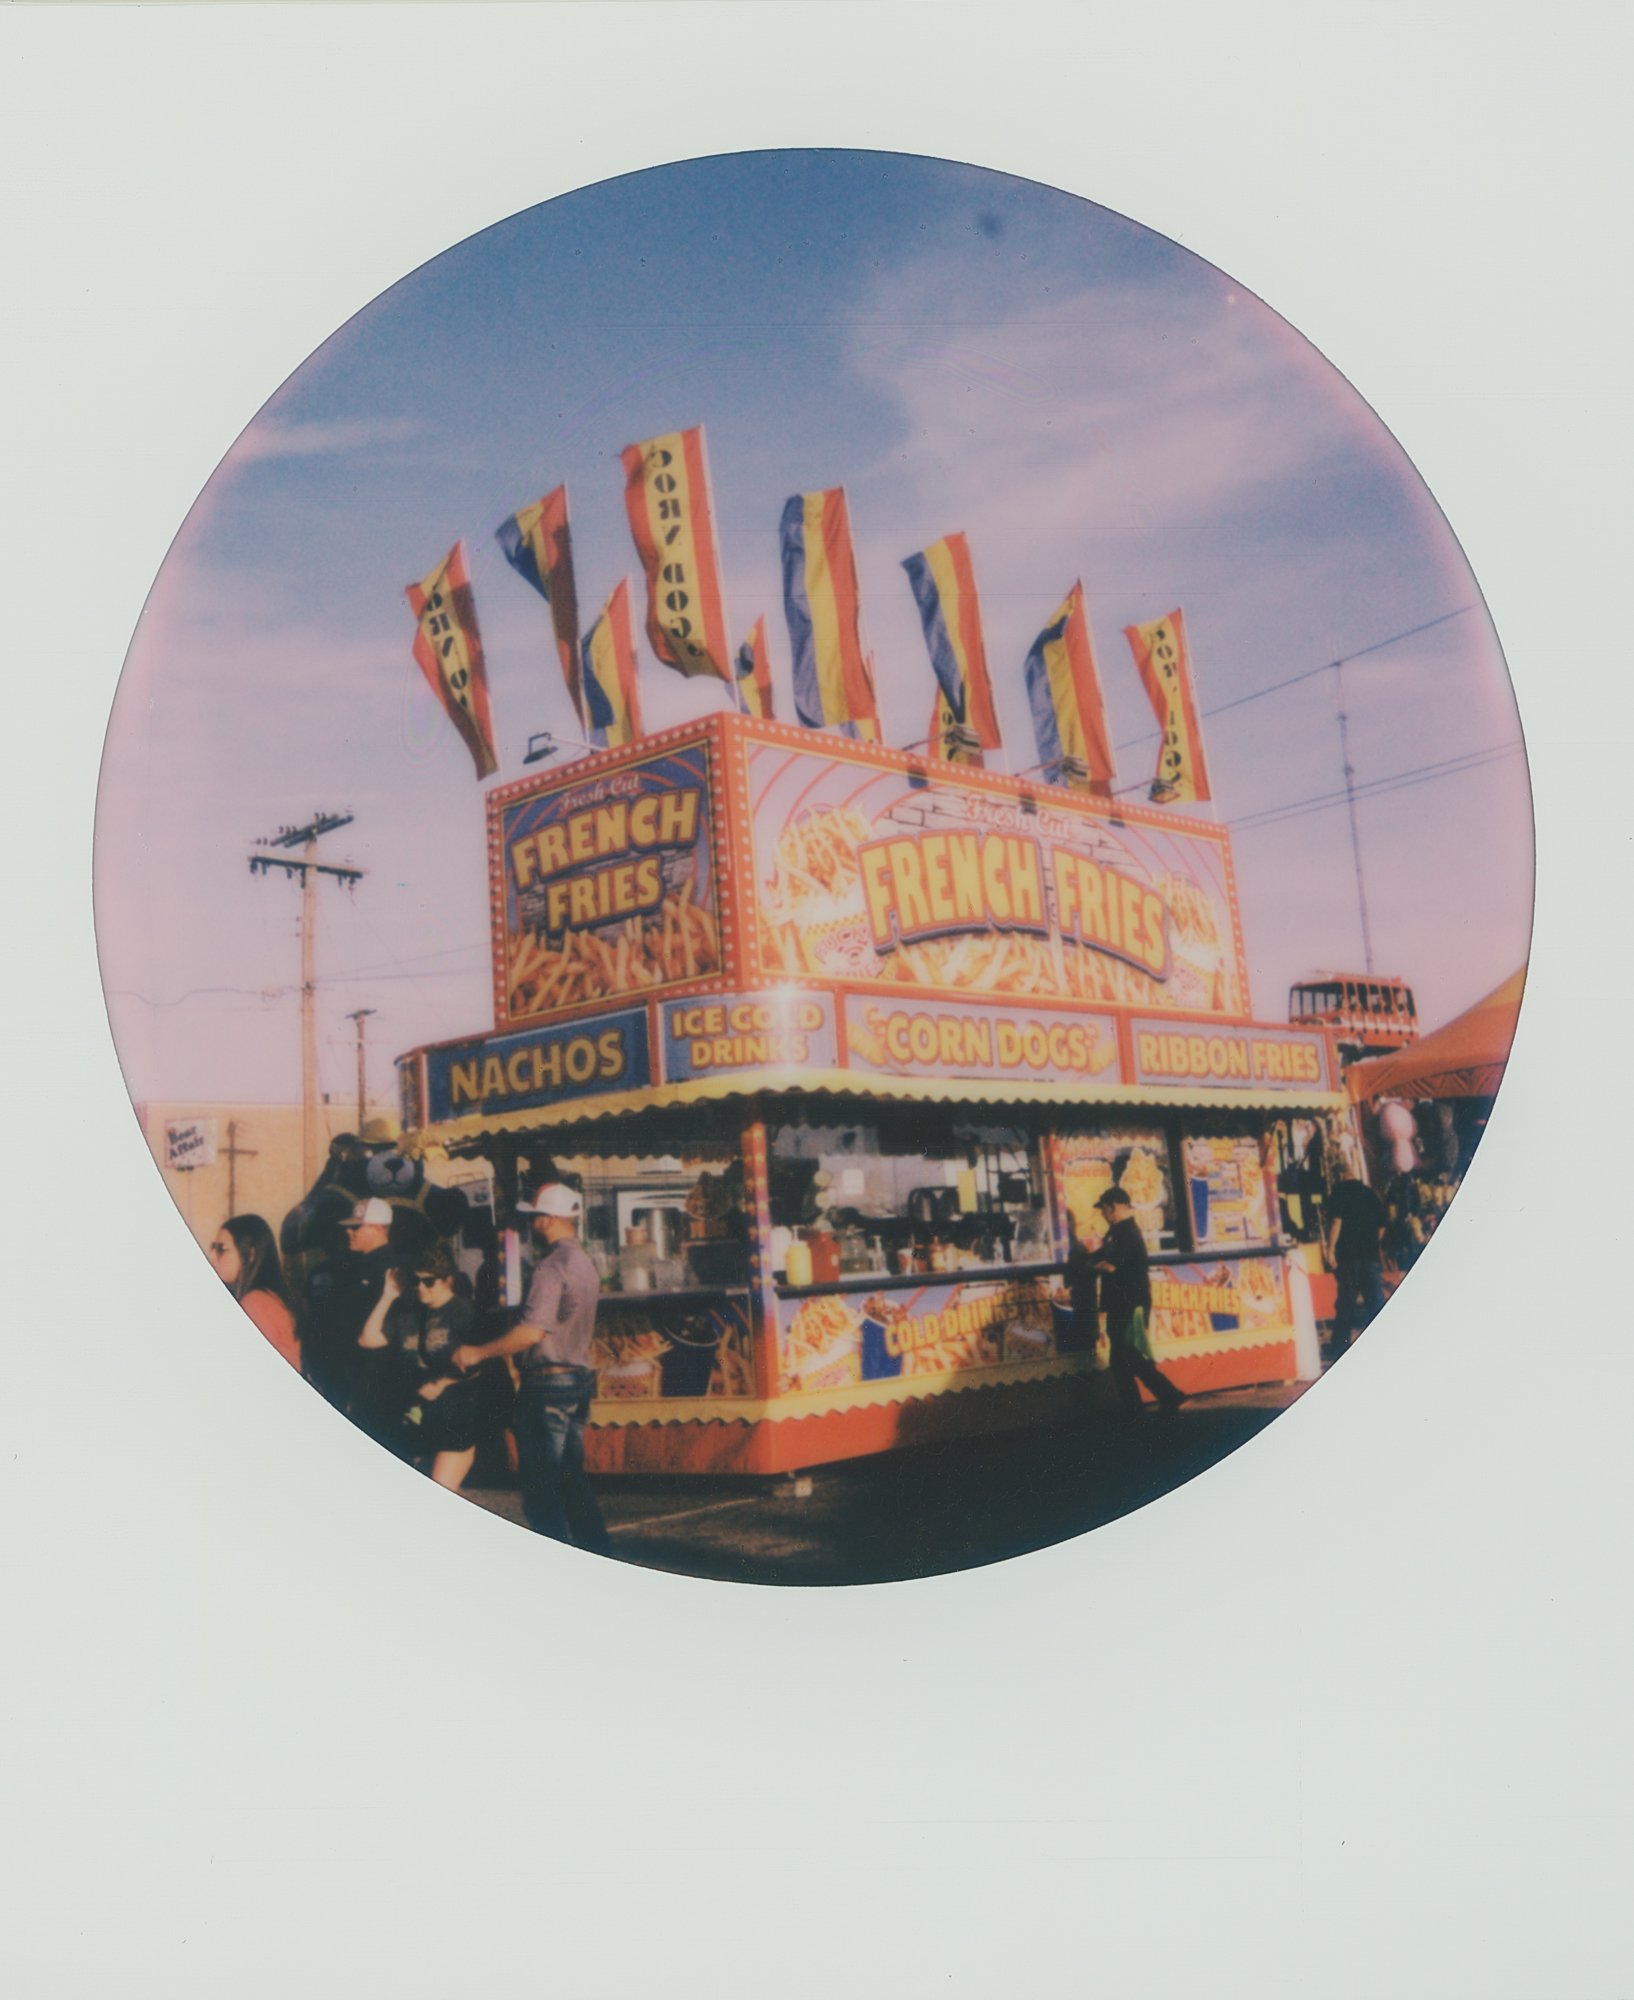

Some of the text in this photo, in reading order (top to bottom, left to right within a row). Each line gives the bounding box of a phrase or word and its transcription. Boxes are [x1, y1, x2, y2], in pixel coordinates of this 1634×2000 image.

[509, 789, 701, 891] FRENCH
[967, 794, 1073, 839] Fresh Cut
[547, 855, 662, 932] FRIES
[858, 831, 1167, 975] FRENCH FRIES
[672, 1003, 825, 1038] ICE COD
[886, 1012, 1088, 1071] CORN DOGS
[450, 1030, 625, 1105] NACHOS
[1138, 1030, 1321, 1082] RIBBON FRIES
[885, 1291, 1019, 1358] COLD DRINKS
[1151, 1280, 1202, 1312] RENCH
